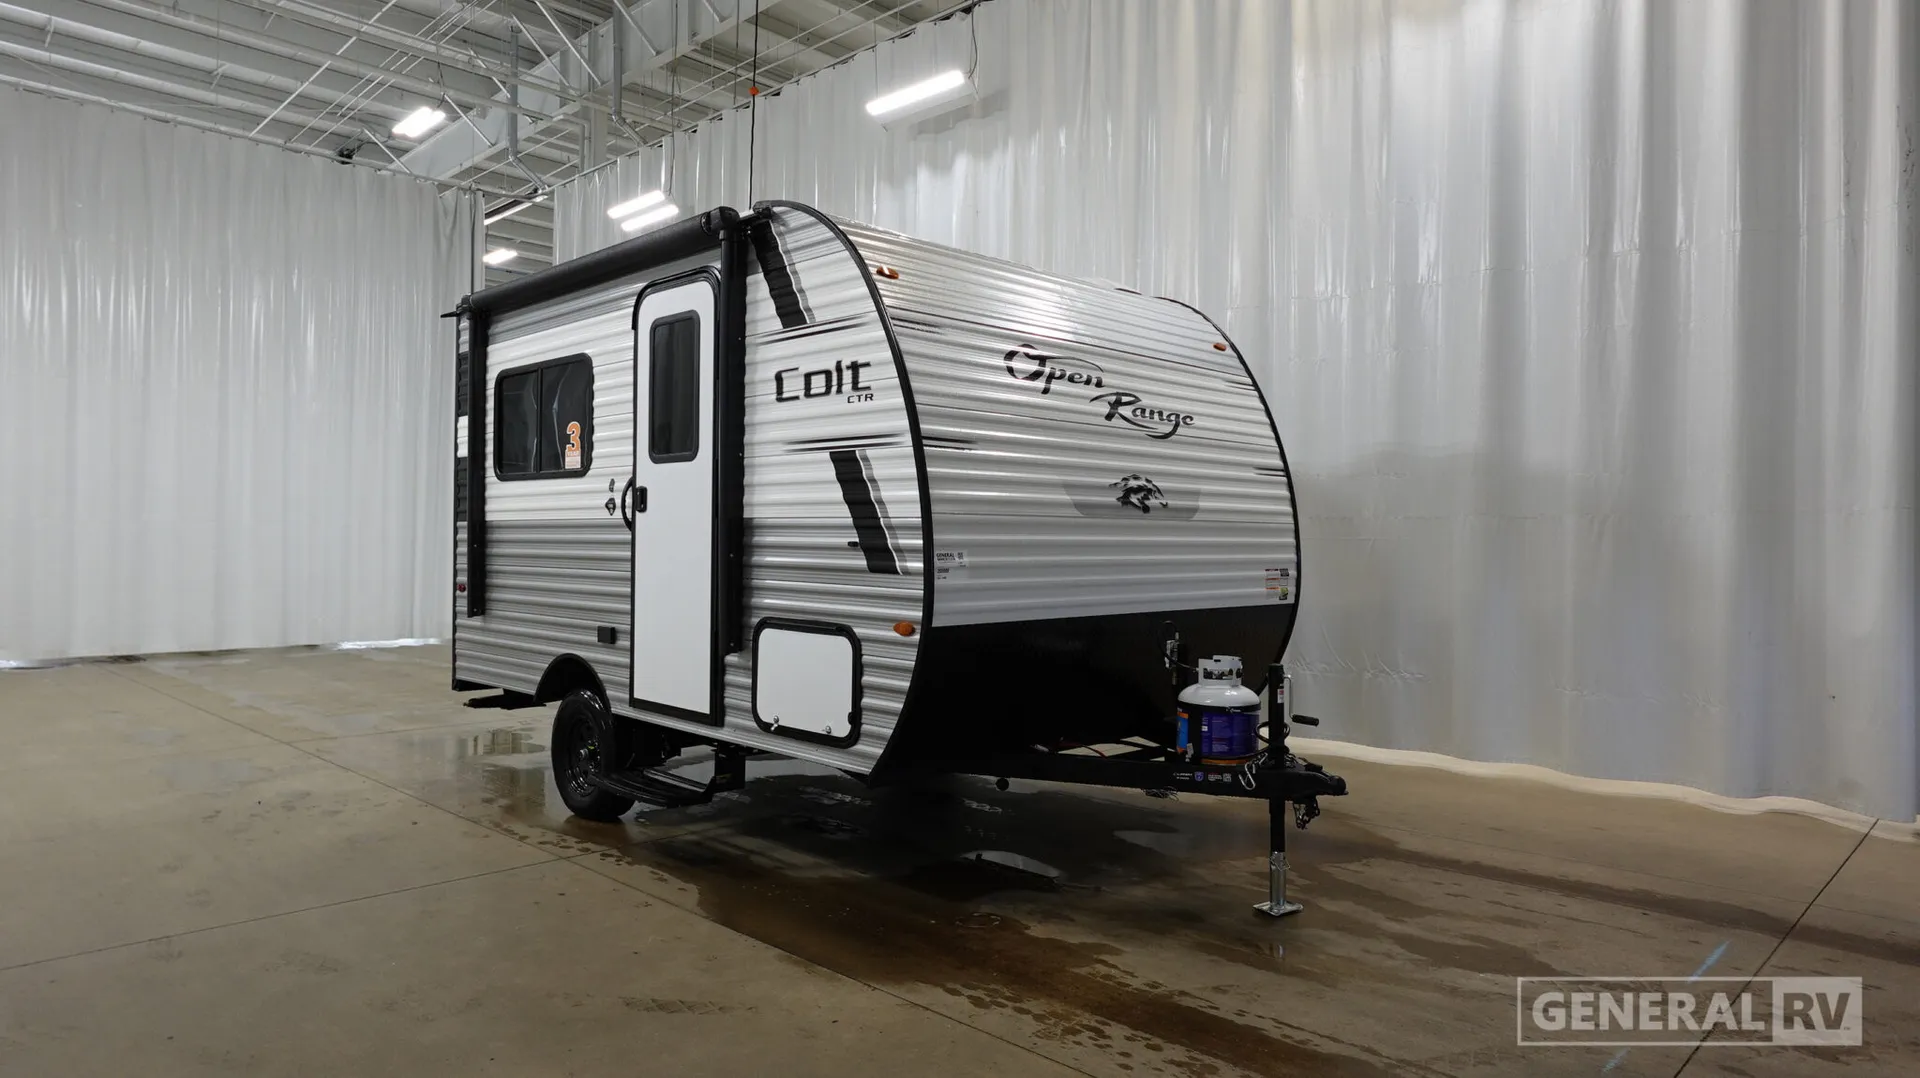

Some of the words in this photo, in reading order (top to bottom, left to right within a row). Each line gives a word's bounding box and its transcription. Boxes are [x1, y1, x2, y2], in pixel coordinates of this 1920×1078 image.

[774, 359, 872, 403] Colt
[1003, 343, 1105, 395] Open
[847, 393, 874, 404] CTR
[1089, 391, 1195, 440] Range
[566, 421, 581, 452] 3
